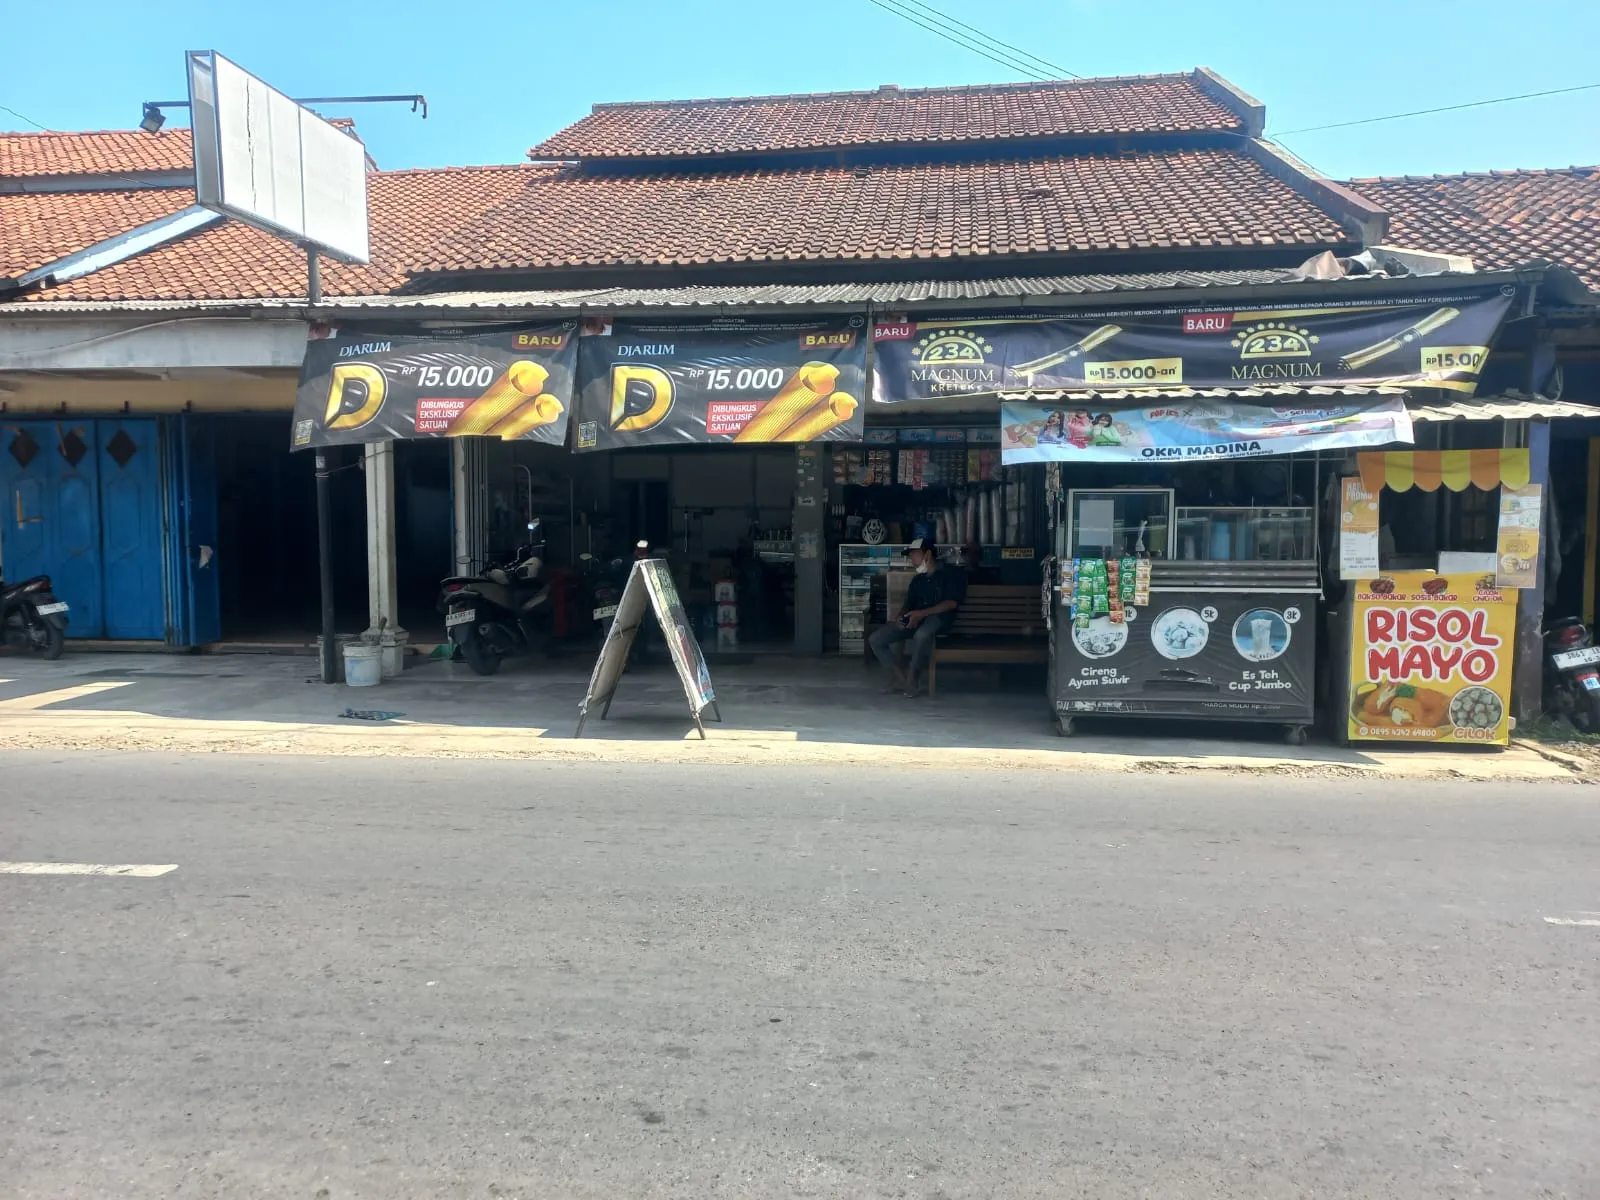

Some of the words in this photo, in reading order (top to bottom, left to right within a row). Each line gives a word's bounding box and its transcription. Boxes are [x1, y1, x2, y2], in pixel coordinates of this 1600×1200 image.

[1186, 318, 1225, 331] BARU
[875, 326, 909, 338] BARU
[518, 334, 562, 346] BARU
[806, 334, 850, 345] BARU
[1249, 335, 1302, 353] 234
[339, 341, 391, 357] DJARUM
[617, 344, 675, 357] DJARUM
[928, 342, 976, 360] 234
[402, 366, 417, 375] RP
[417, 366, 494, 387] 15.000
[911, 368, 993, 382] MAGNUM
[1231, 362, 1321, 381] MAGNUM
[689, 369, 705, 378] RP
[706, 368, 784, 390] 15.000
[421, 401, 465, 410] DIBUNGKUS
[712, 404, 757, 413] DIBUNGKUS
[419, 410, 461, 419] EKSKLUSIF
[711, 413, 753, 422] EKSKLUSIF
[419, 420, 448, 429] SATUAN
[711, 423, 741, 431] SATUAN
[1141, 447, 1182, 458] OKM
[1187, 441, 1262, 456] MADINA
[1367, 609, 1500, 647] RISOL
[1367, 645, 1497, 683] MAYO
[1081, 666, 1118, 678] Cireng
[1242, 670, 1256, 680] Es
[1258, 670, 1279, 680] Teh
[1068, 677, 1099, 690] Ayam
[1101, 675, 1131, 686] Suwir
[1228, 680, 1252, 692] Cup
[1253, 679, 1292, 690] Jumbo
